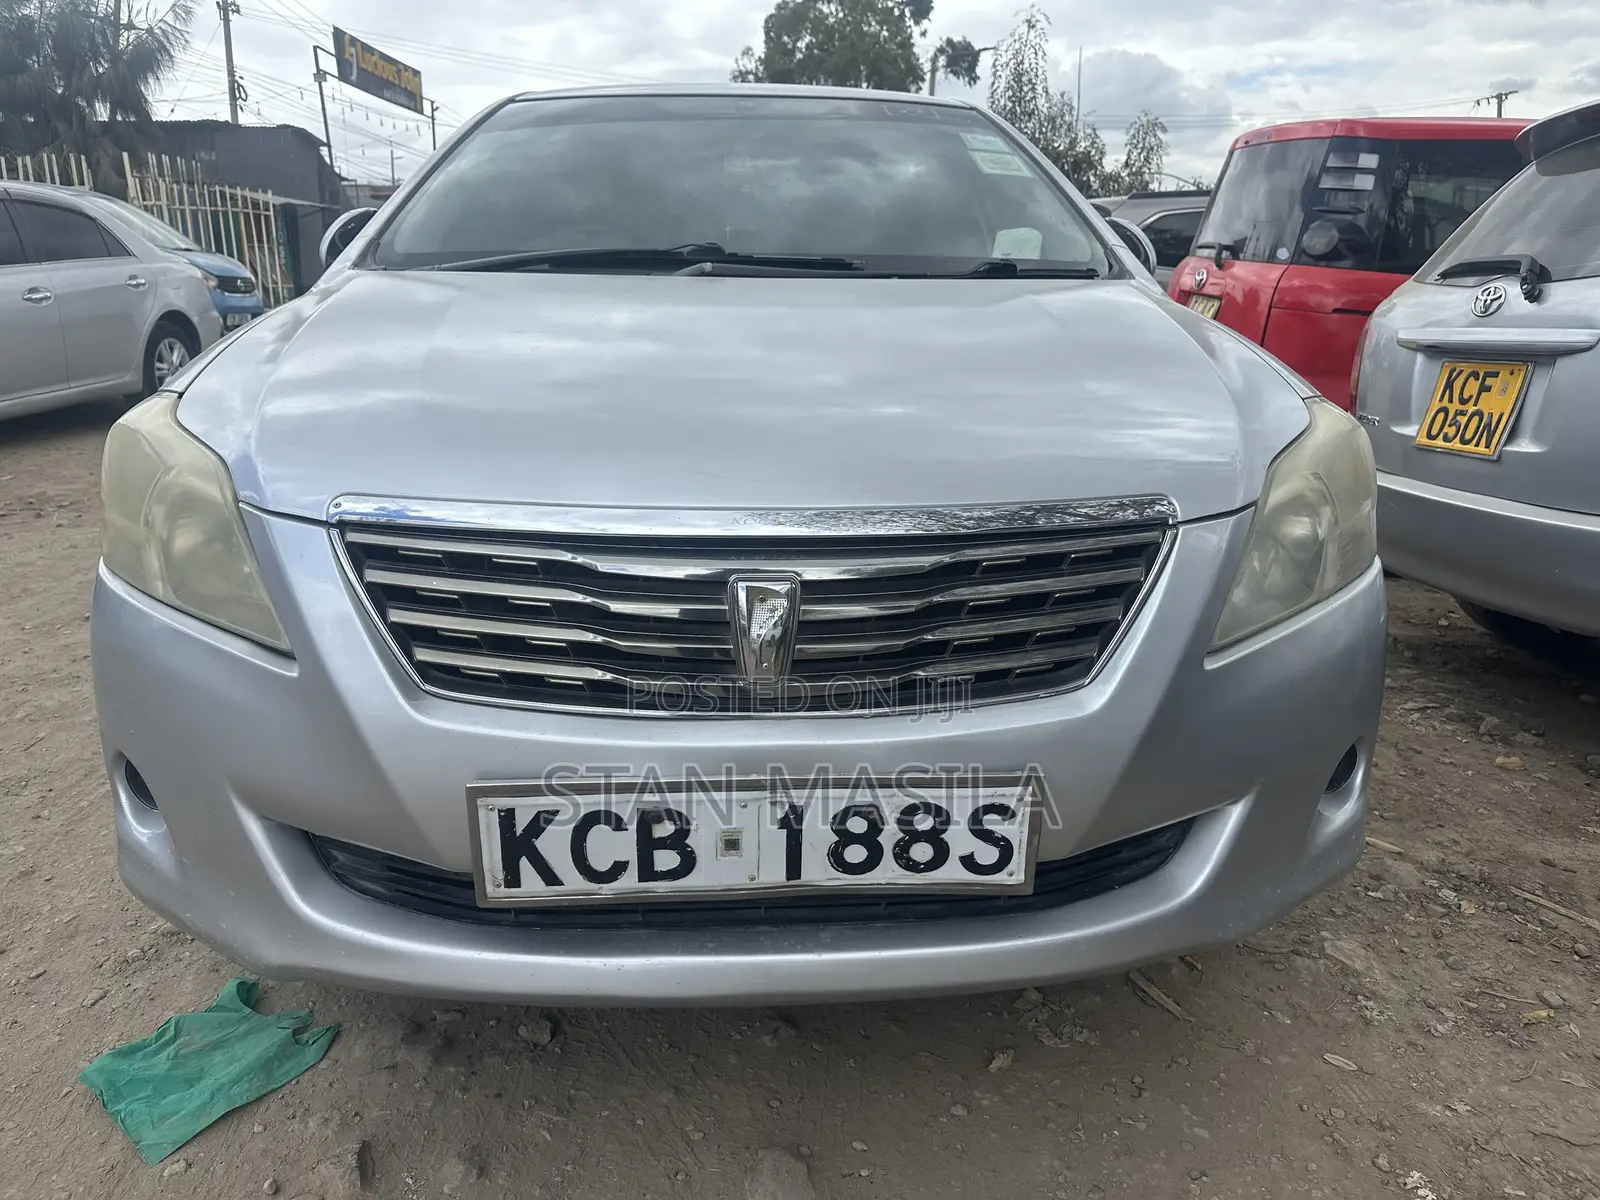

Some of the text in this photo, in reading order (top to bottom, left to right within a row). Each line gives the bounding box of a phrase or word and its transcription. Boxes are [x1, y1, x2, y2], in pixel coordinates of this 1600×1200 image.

[1438, 366, 1501, 407] KCF
[498, 801, 1017, 889] KCB 188S
